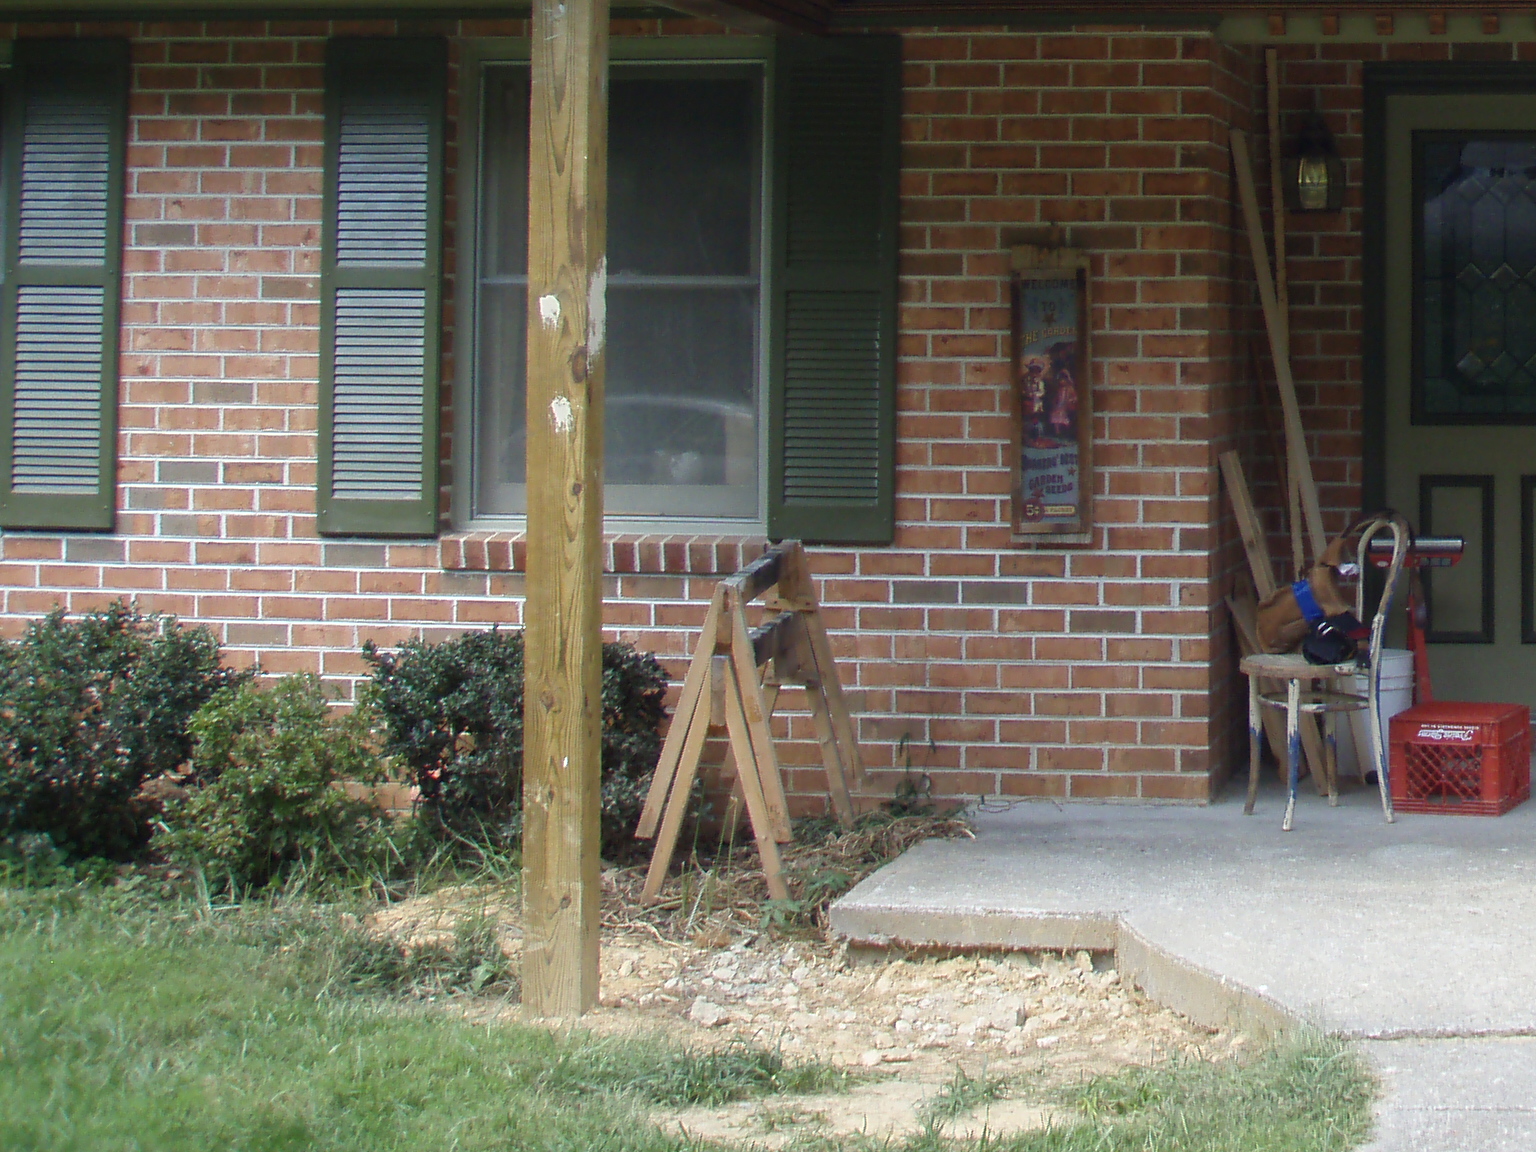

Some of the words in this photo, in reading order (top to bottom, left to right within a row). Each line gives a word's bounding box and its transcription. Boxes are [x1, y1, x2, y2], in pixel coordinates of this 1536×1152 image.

[1021, 279, 1076, 290] WELCOME
[1041, 301, 1056, 312] TO
[1029, 474, 1064, 490] GARDEN
[1045, 482, 1073, 494] SEEDS
